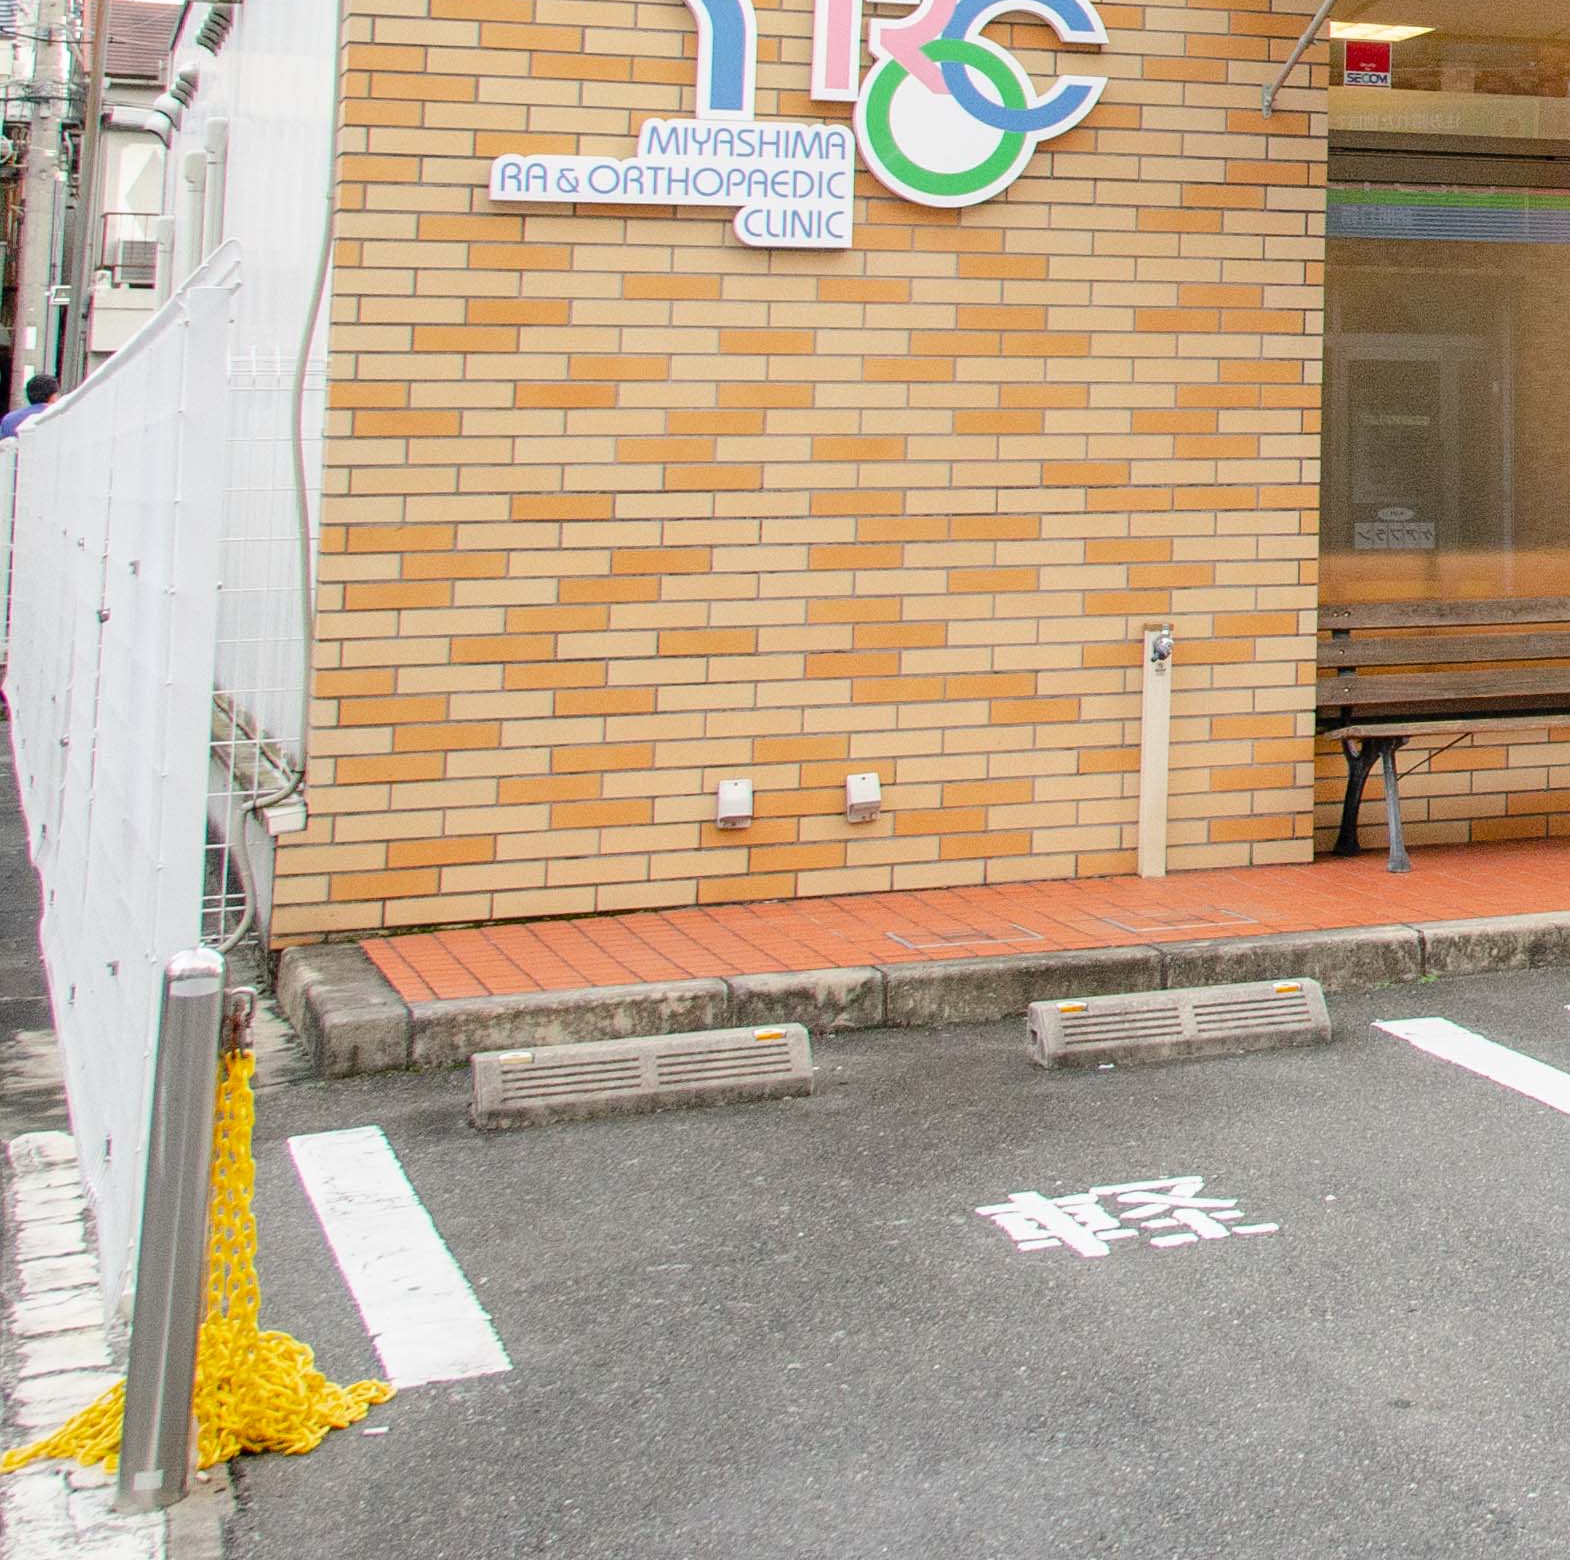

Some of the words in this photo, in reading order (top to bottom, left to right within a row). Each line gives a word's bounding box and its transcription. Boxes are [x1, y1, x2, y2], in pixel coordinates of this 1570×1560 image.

[1347, 72, 1388, 85] SECOM
[646, 126, 847, 161] MIYASHIMA
[499, 162, 549, 194] RA
[557, 166, 581, 195] &
[588, 163, 846, 199] ORTHOPAEDIC
[743, 208, 845, 240] CLINIC
